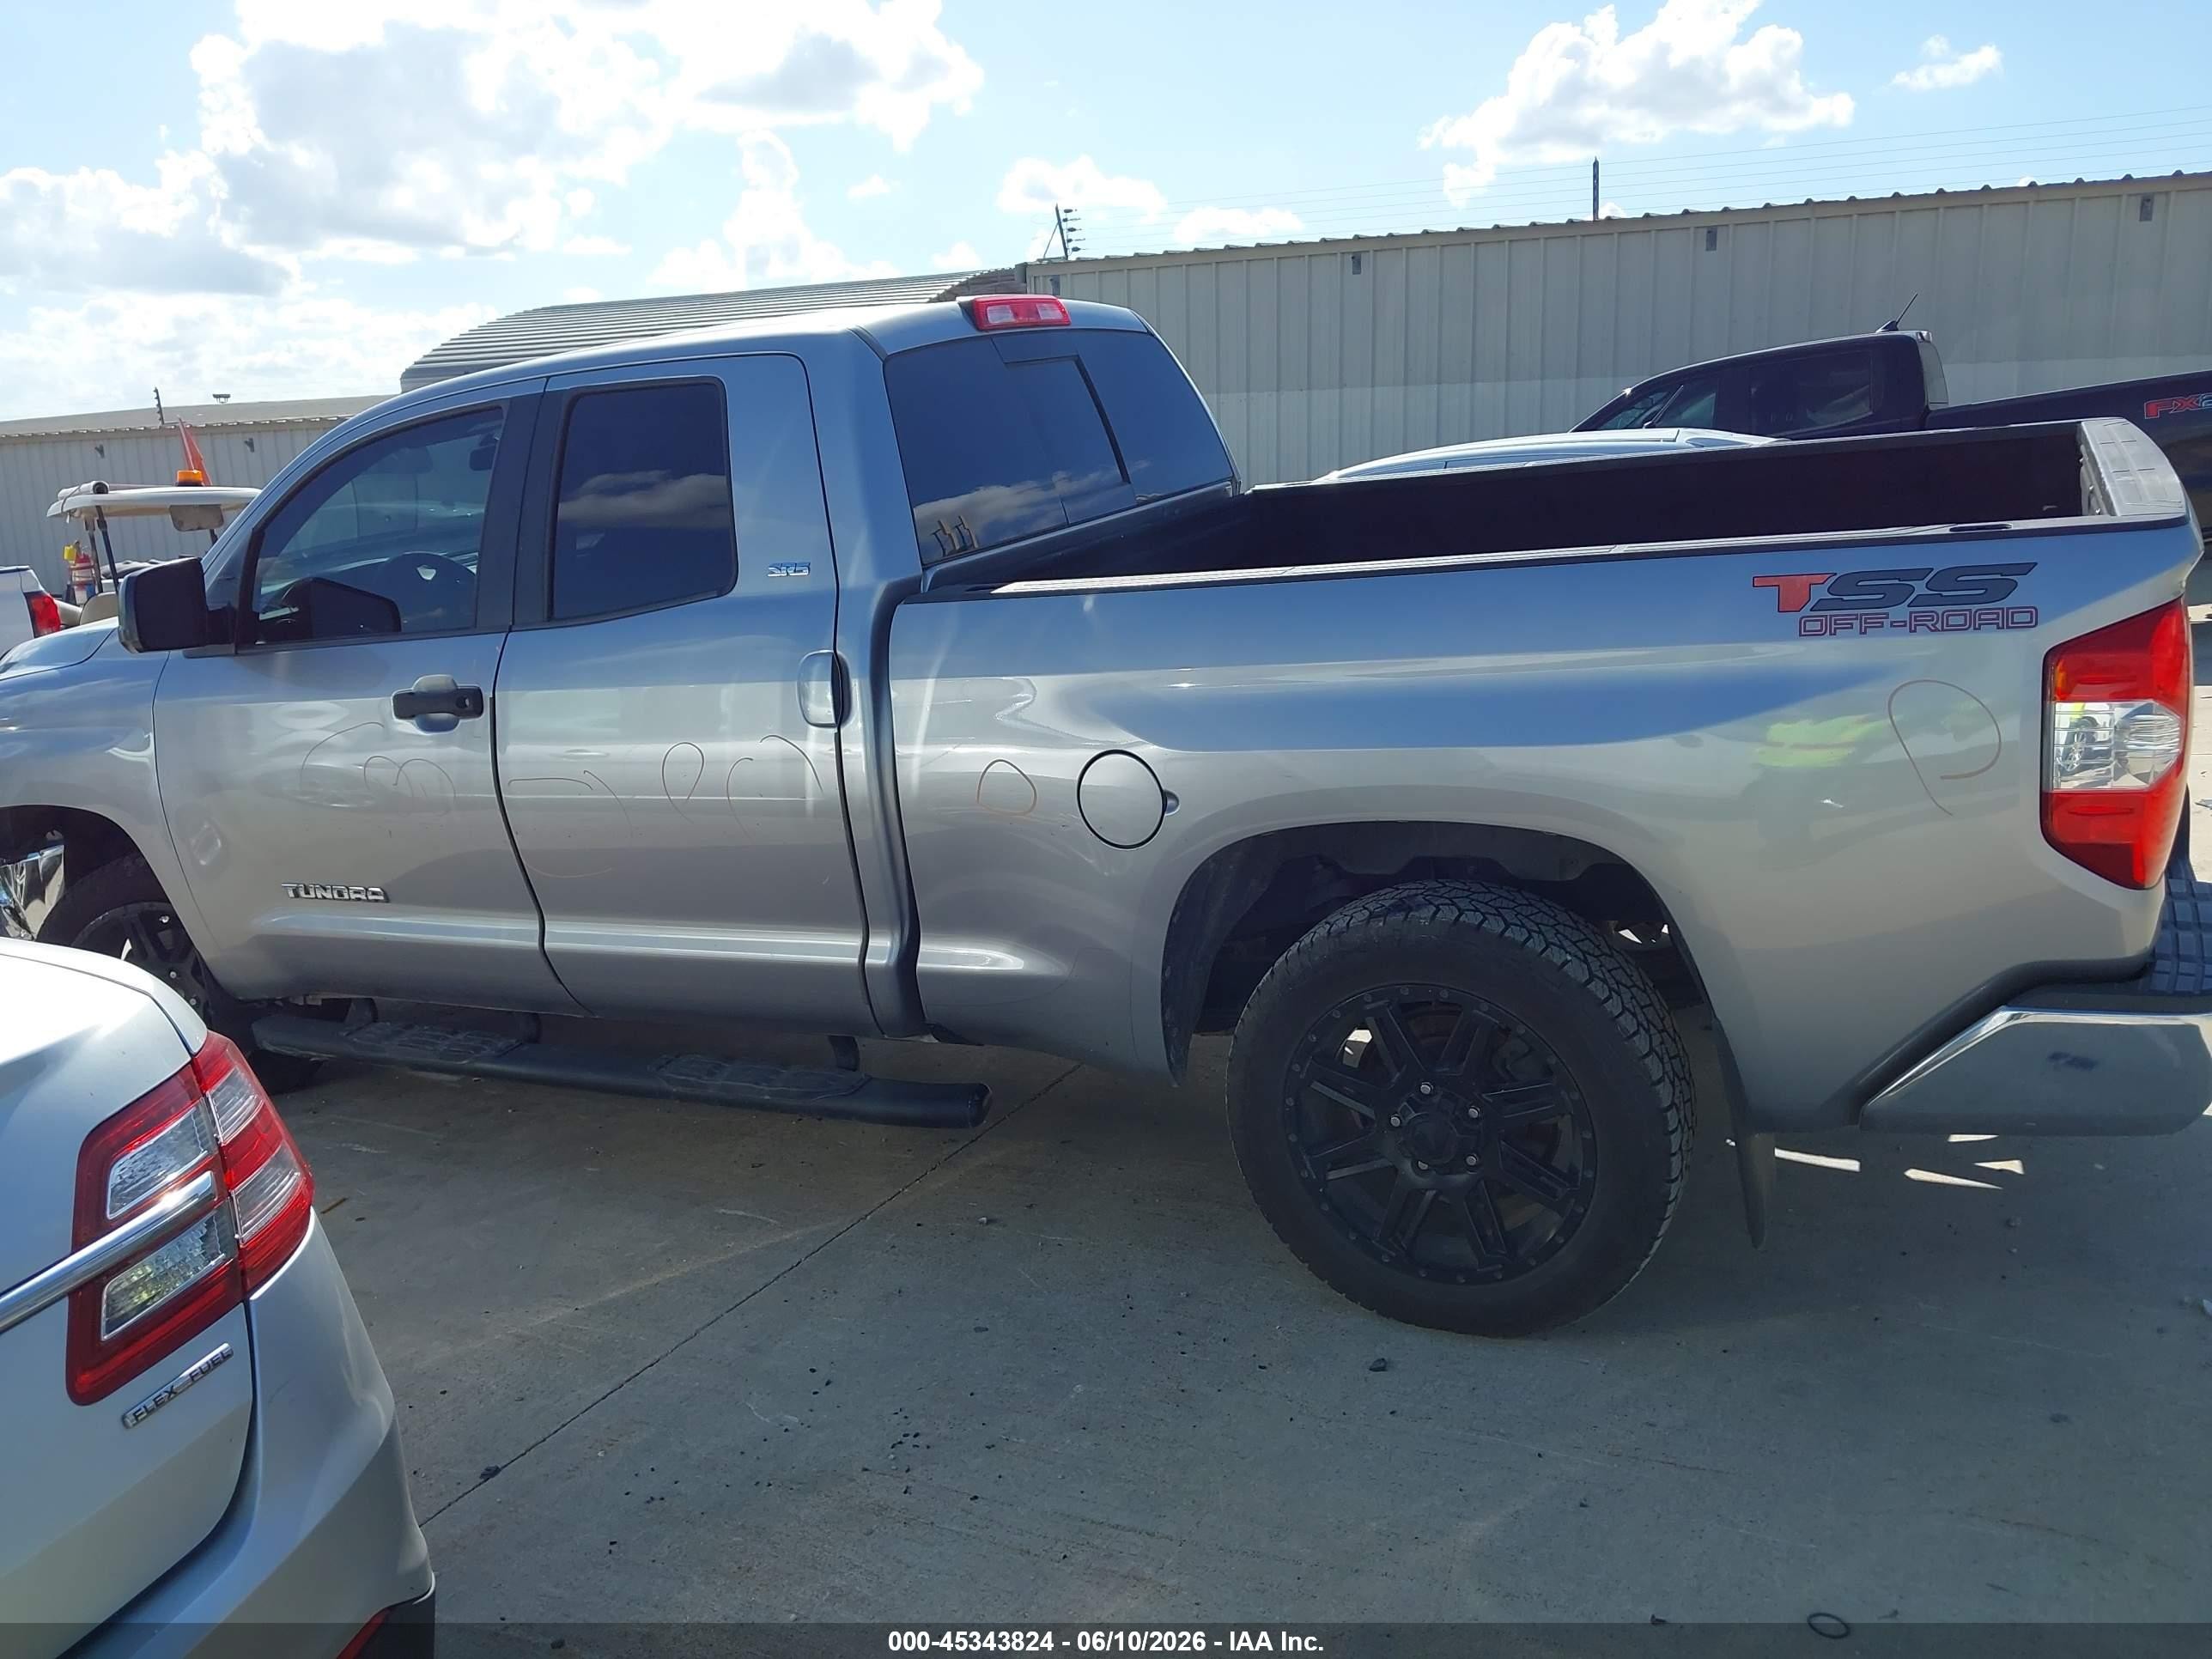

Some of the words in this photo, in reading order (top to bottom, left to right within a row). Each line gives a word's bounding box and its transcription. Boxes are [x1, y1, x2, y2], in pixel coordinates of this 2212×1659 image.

[1752, 562, 2039, 613] TSS
[1798, 605, 2039, 637] OFF-ROAD
[281, 883, 390, 902] TUNDRA
[131, 1384, 179, 1423] FLEX
[188, 1347, 234, 1382] FUEL
